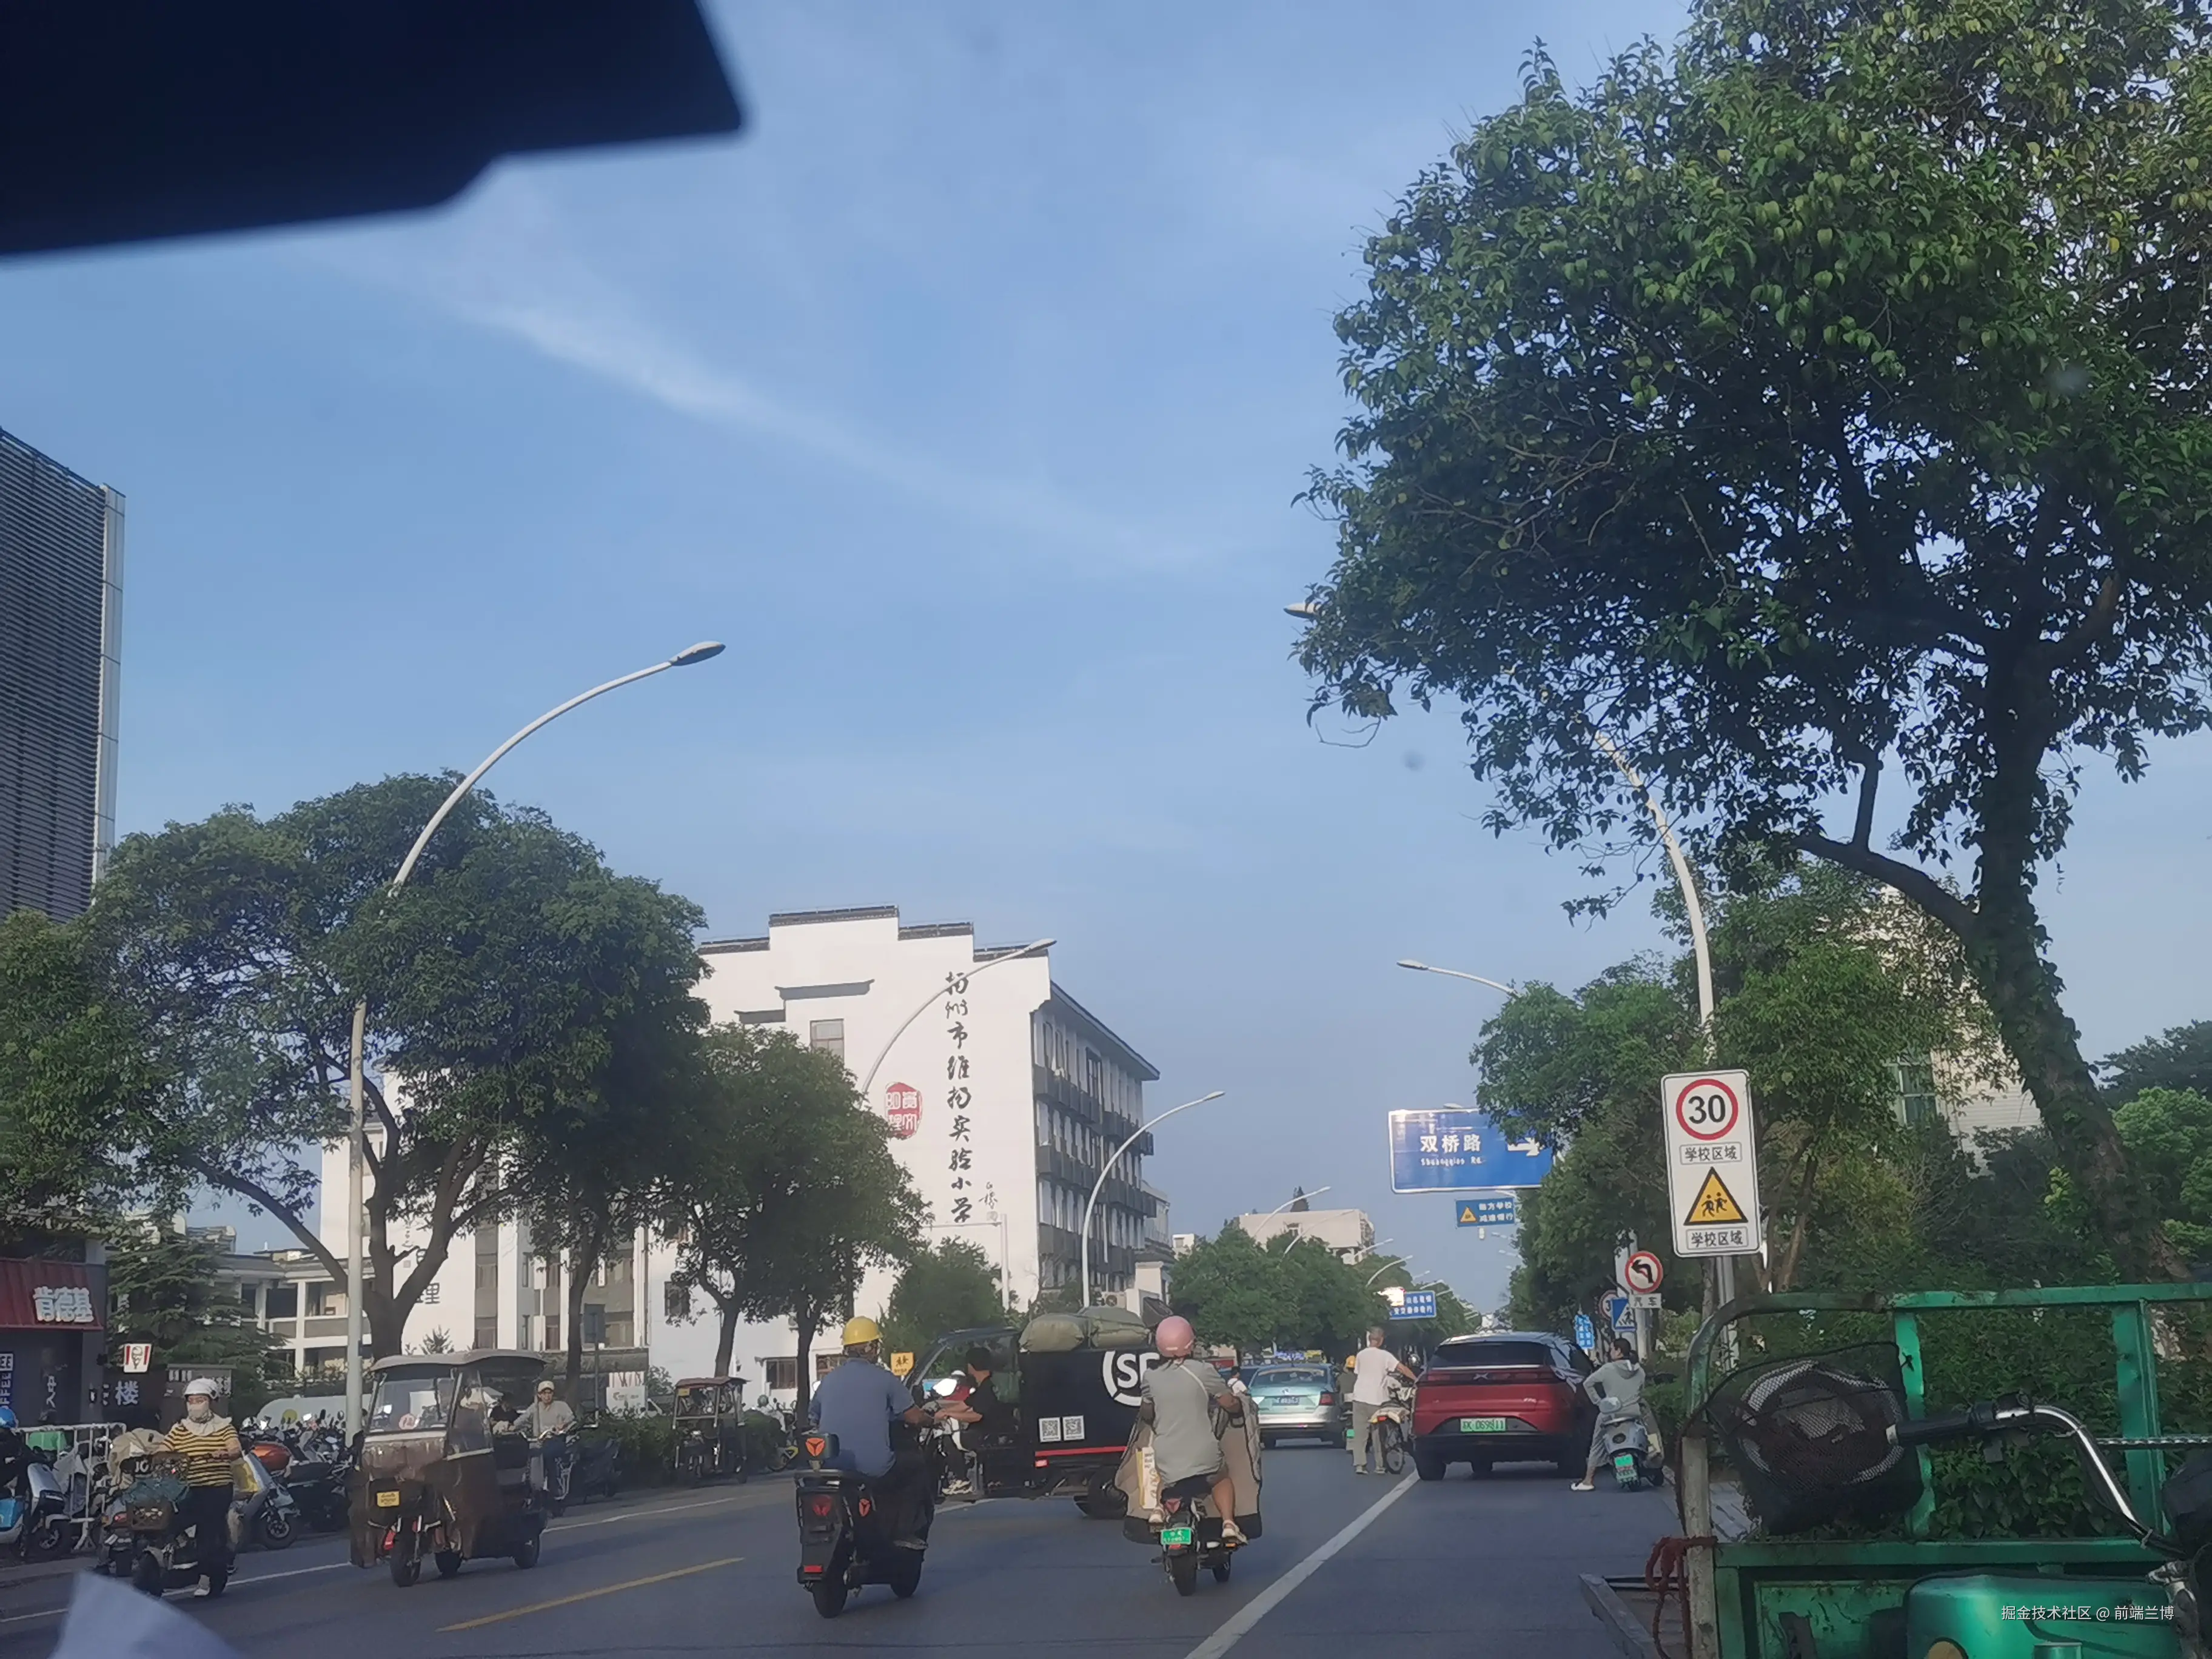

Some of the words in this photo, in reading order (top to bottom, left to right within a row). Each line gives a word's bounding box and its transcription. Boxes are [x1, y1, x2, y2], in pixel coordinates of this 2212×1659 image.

[1688, 1094, 1726, 1124] 30
[1420, 1134, 1481, 1153] 双桥路
[1685, 1145, 1737, 1162] 学校区域
[1691, 1230, 1743, 1247] 学校区域
[33, 1286, 94, 1322] 肯德基
